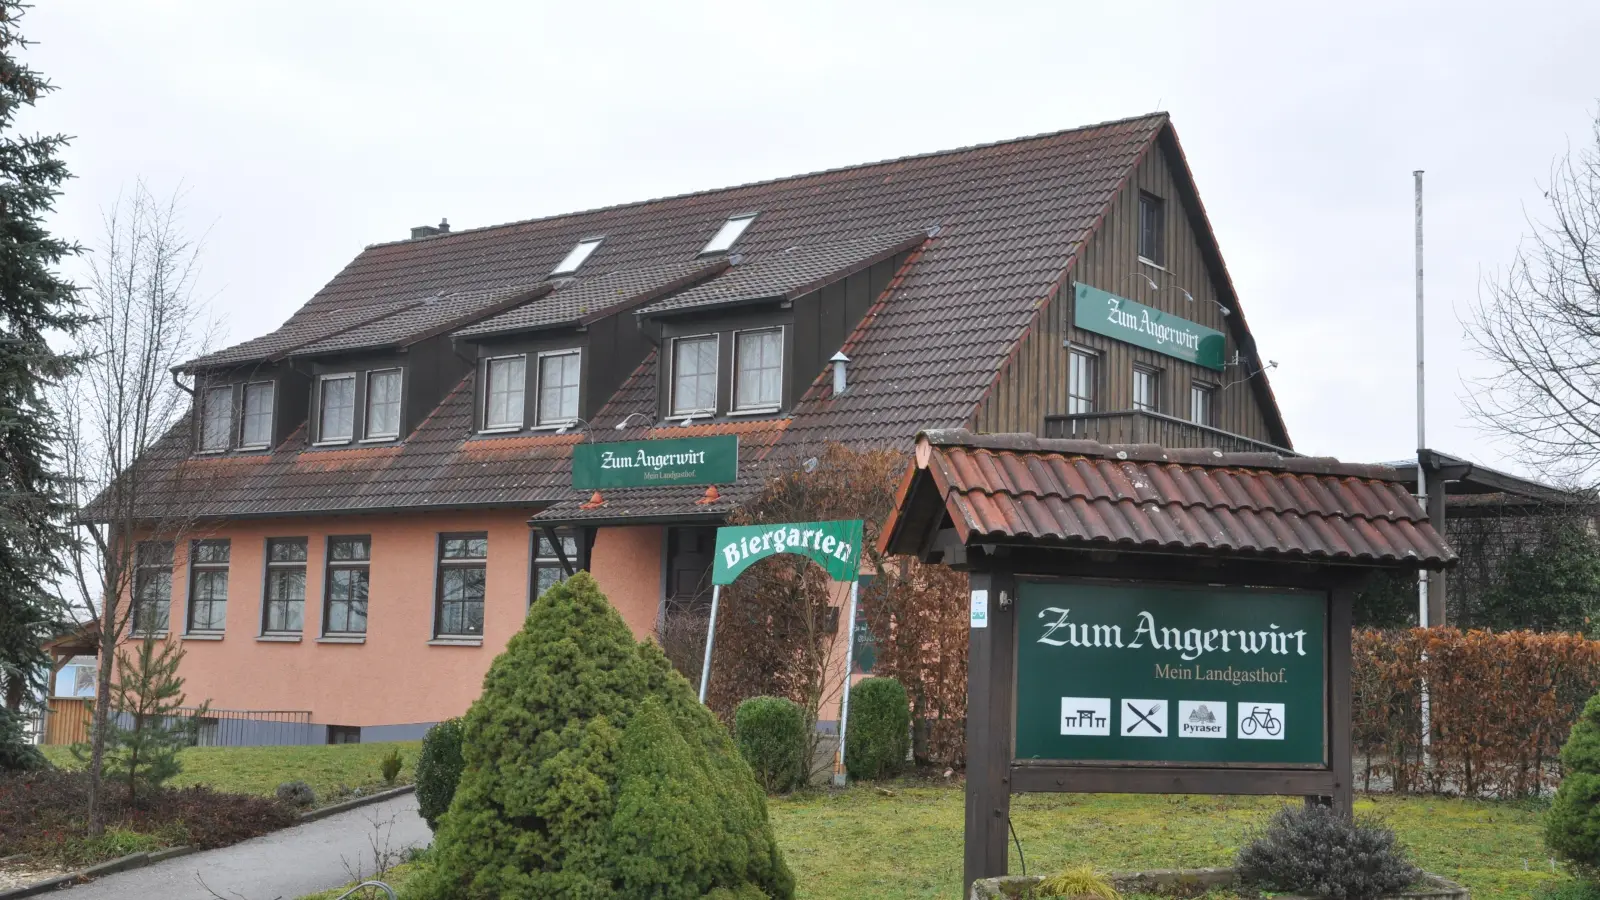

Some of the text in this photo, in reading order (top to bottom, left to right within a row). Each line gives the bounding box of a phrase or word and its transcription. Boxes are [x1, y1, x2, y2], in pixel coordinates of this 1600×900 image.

[1107, 298, 1200, 351] Zum Angerwirt
[601, 449, 705, 470] Zum Angerwirt
[644, 471, 659, 480] Mein
[723, 527, 852, 569] Biergarten
[1037, 606, 1307, 660] Zum Angerwirt
[1155, 664, 1288, 685] Mein Landgasthof.
[1183, 723, 1222, 734] Pyraser
